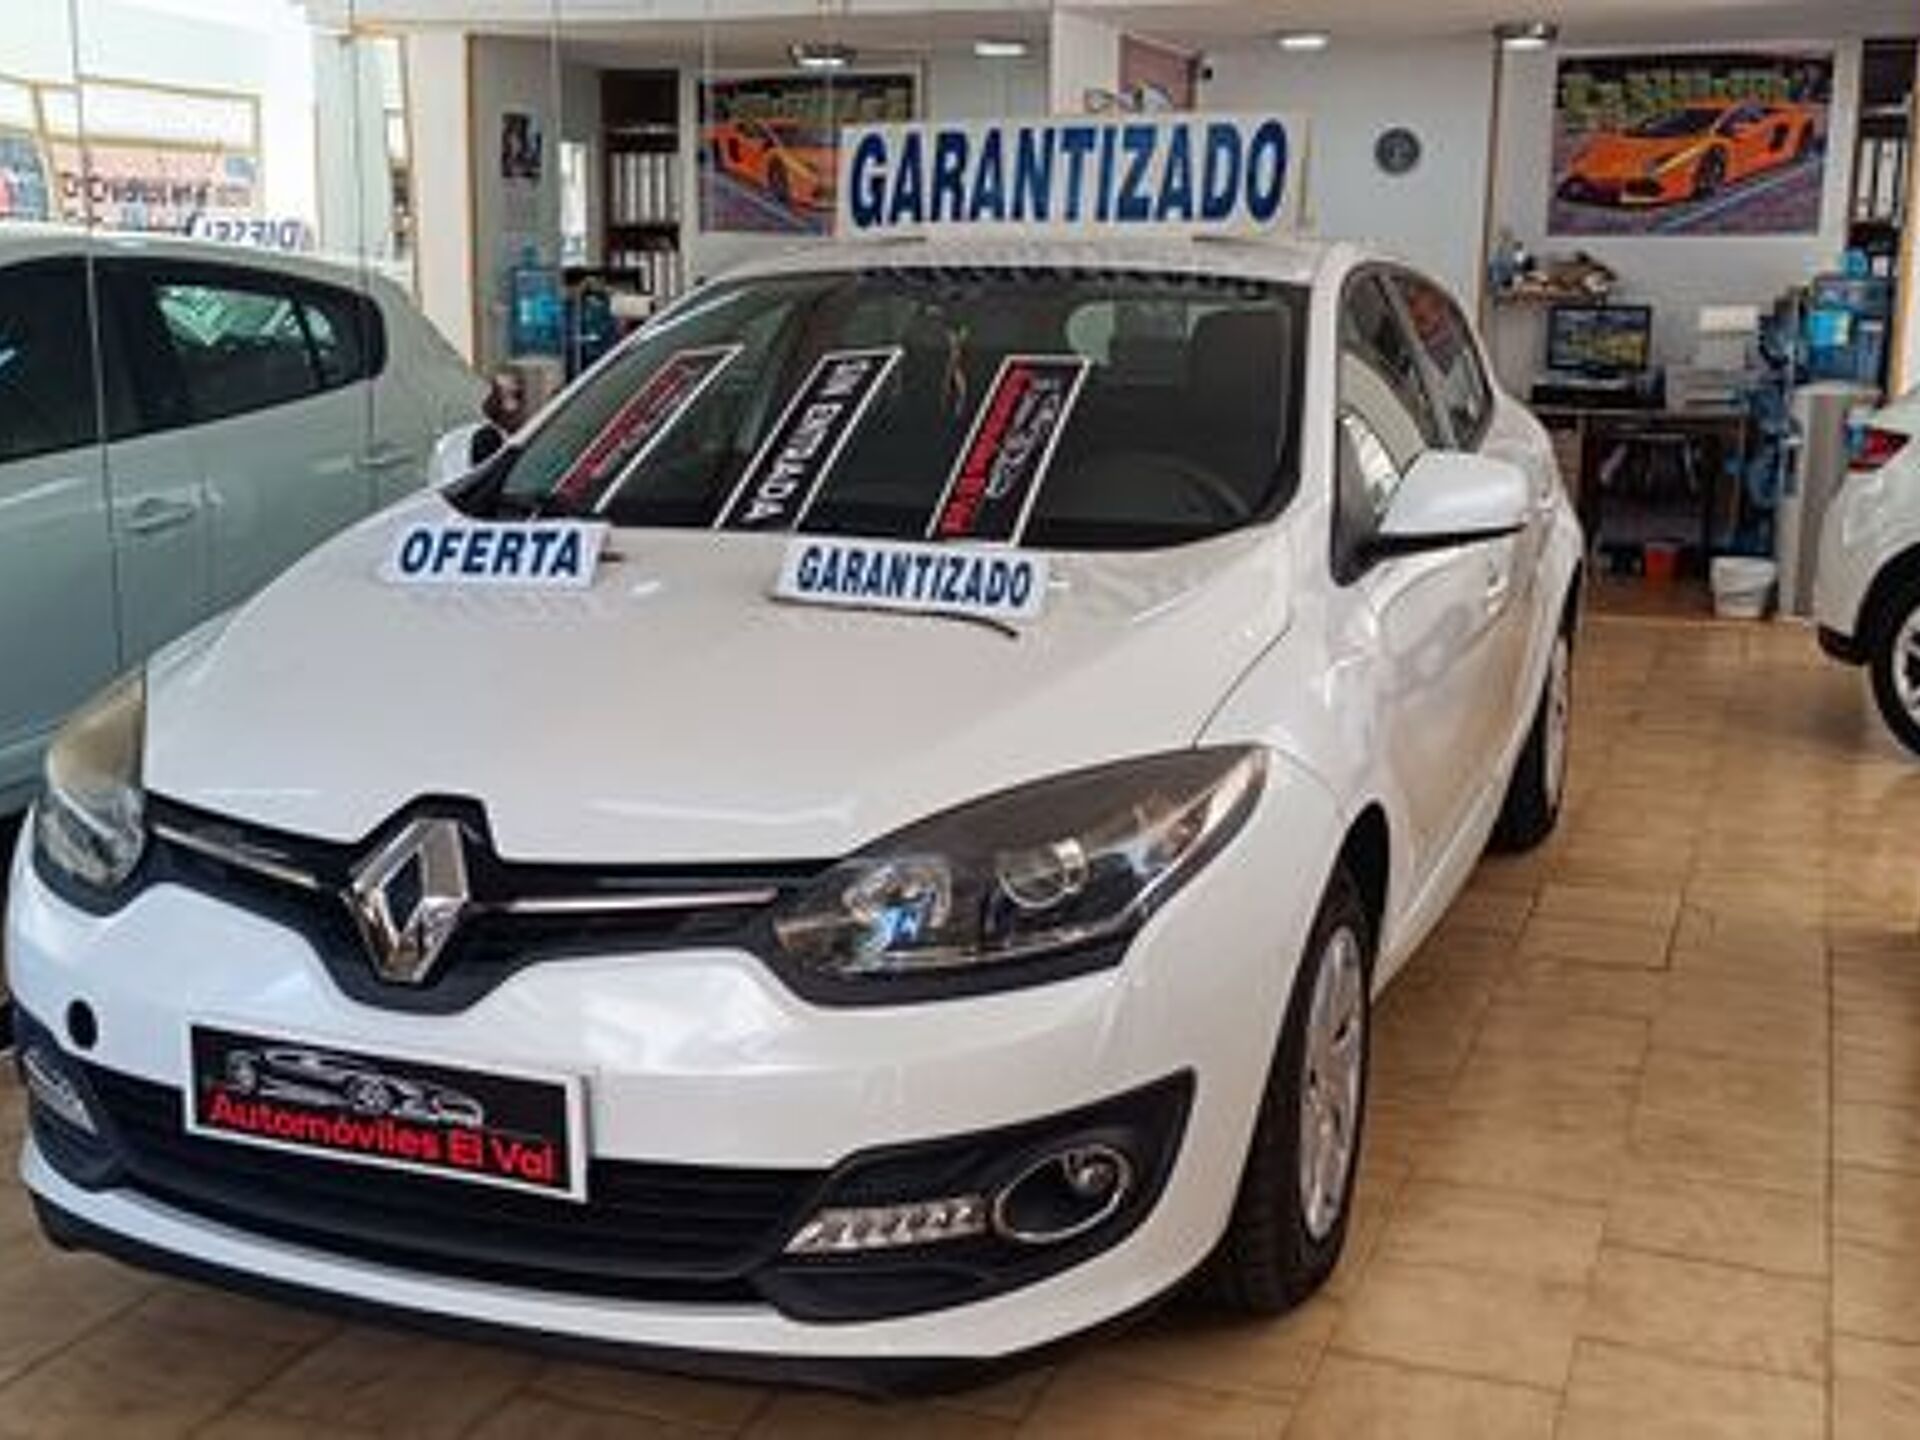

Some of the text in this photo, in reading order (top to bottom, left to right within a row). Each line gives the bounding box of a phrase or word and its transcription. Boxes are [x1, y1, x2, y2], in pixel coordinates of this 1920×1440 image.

[850, 119, 1288, 228] GARANTIZADO
[401, 528, 581, 577] OFERTA
[797, 546, 1032, 608] GARANTIZADO
[208, 1093, 554, 1182] Automóviles El Val
